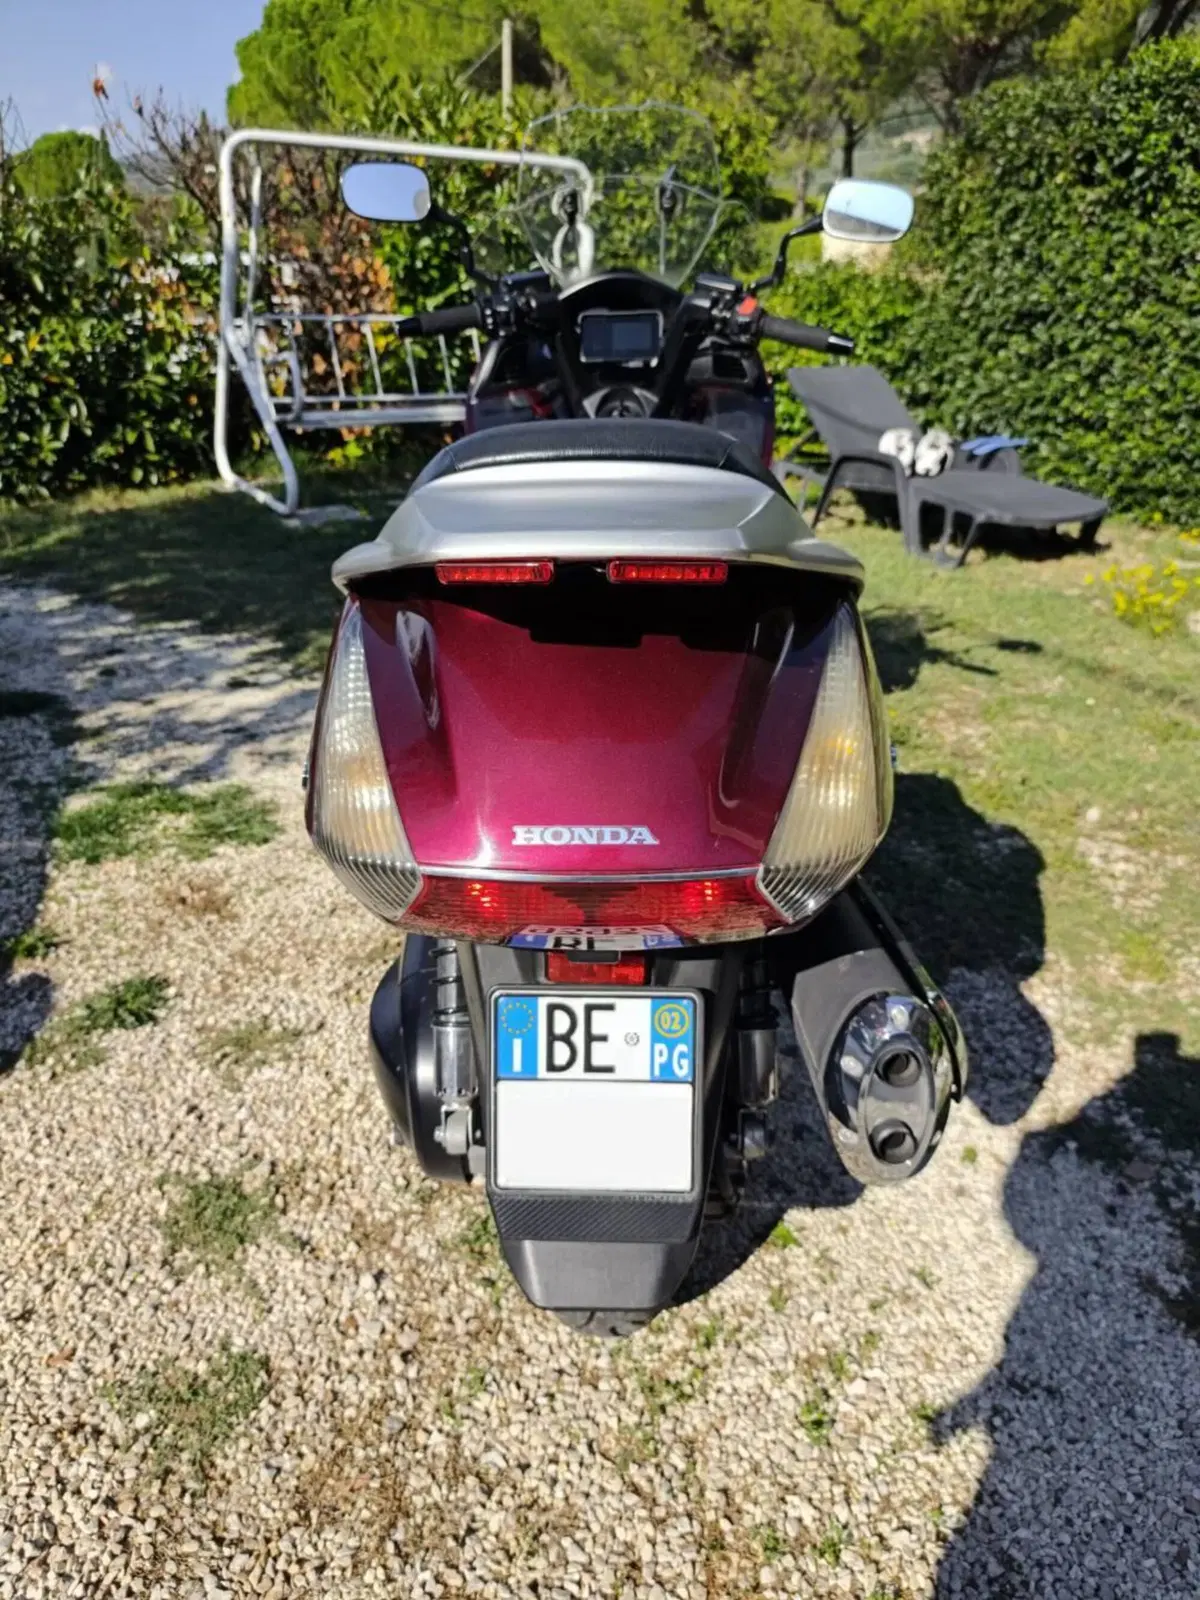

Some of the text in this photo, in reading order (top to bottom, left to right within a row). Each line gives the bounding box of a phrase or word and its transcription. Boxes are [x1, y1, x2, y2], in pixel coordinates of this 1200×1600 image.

[512, 825, 659, 845] HONDA
[546, 1002, 616, 1073] BE
[661, 1011, 681, 1030] 02
[512, 1038, 522, 1073] I
[654, 1043, 689, 1078] PG
